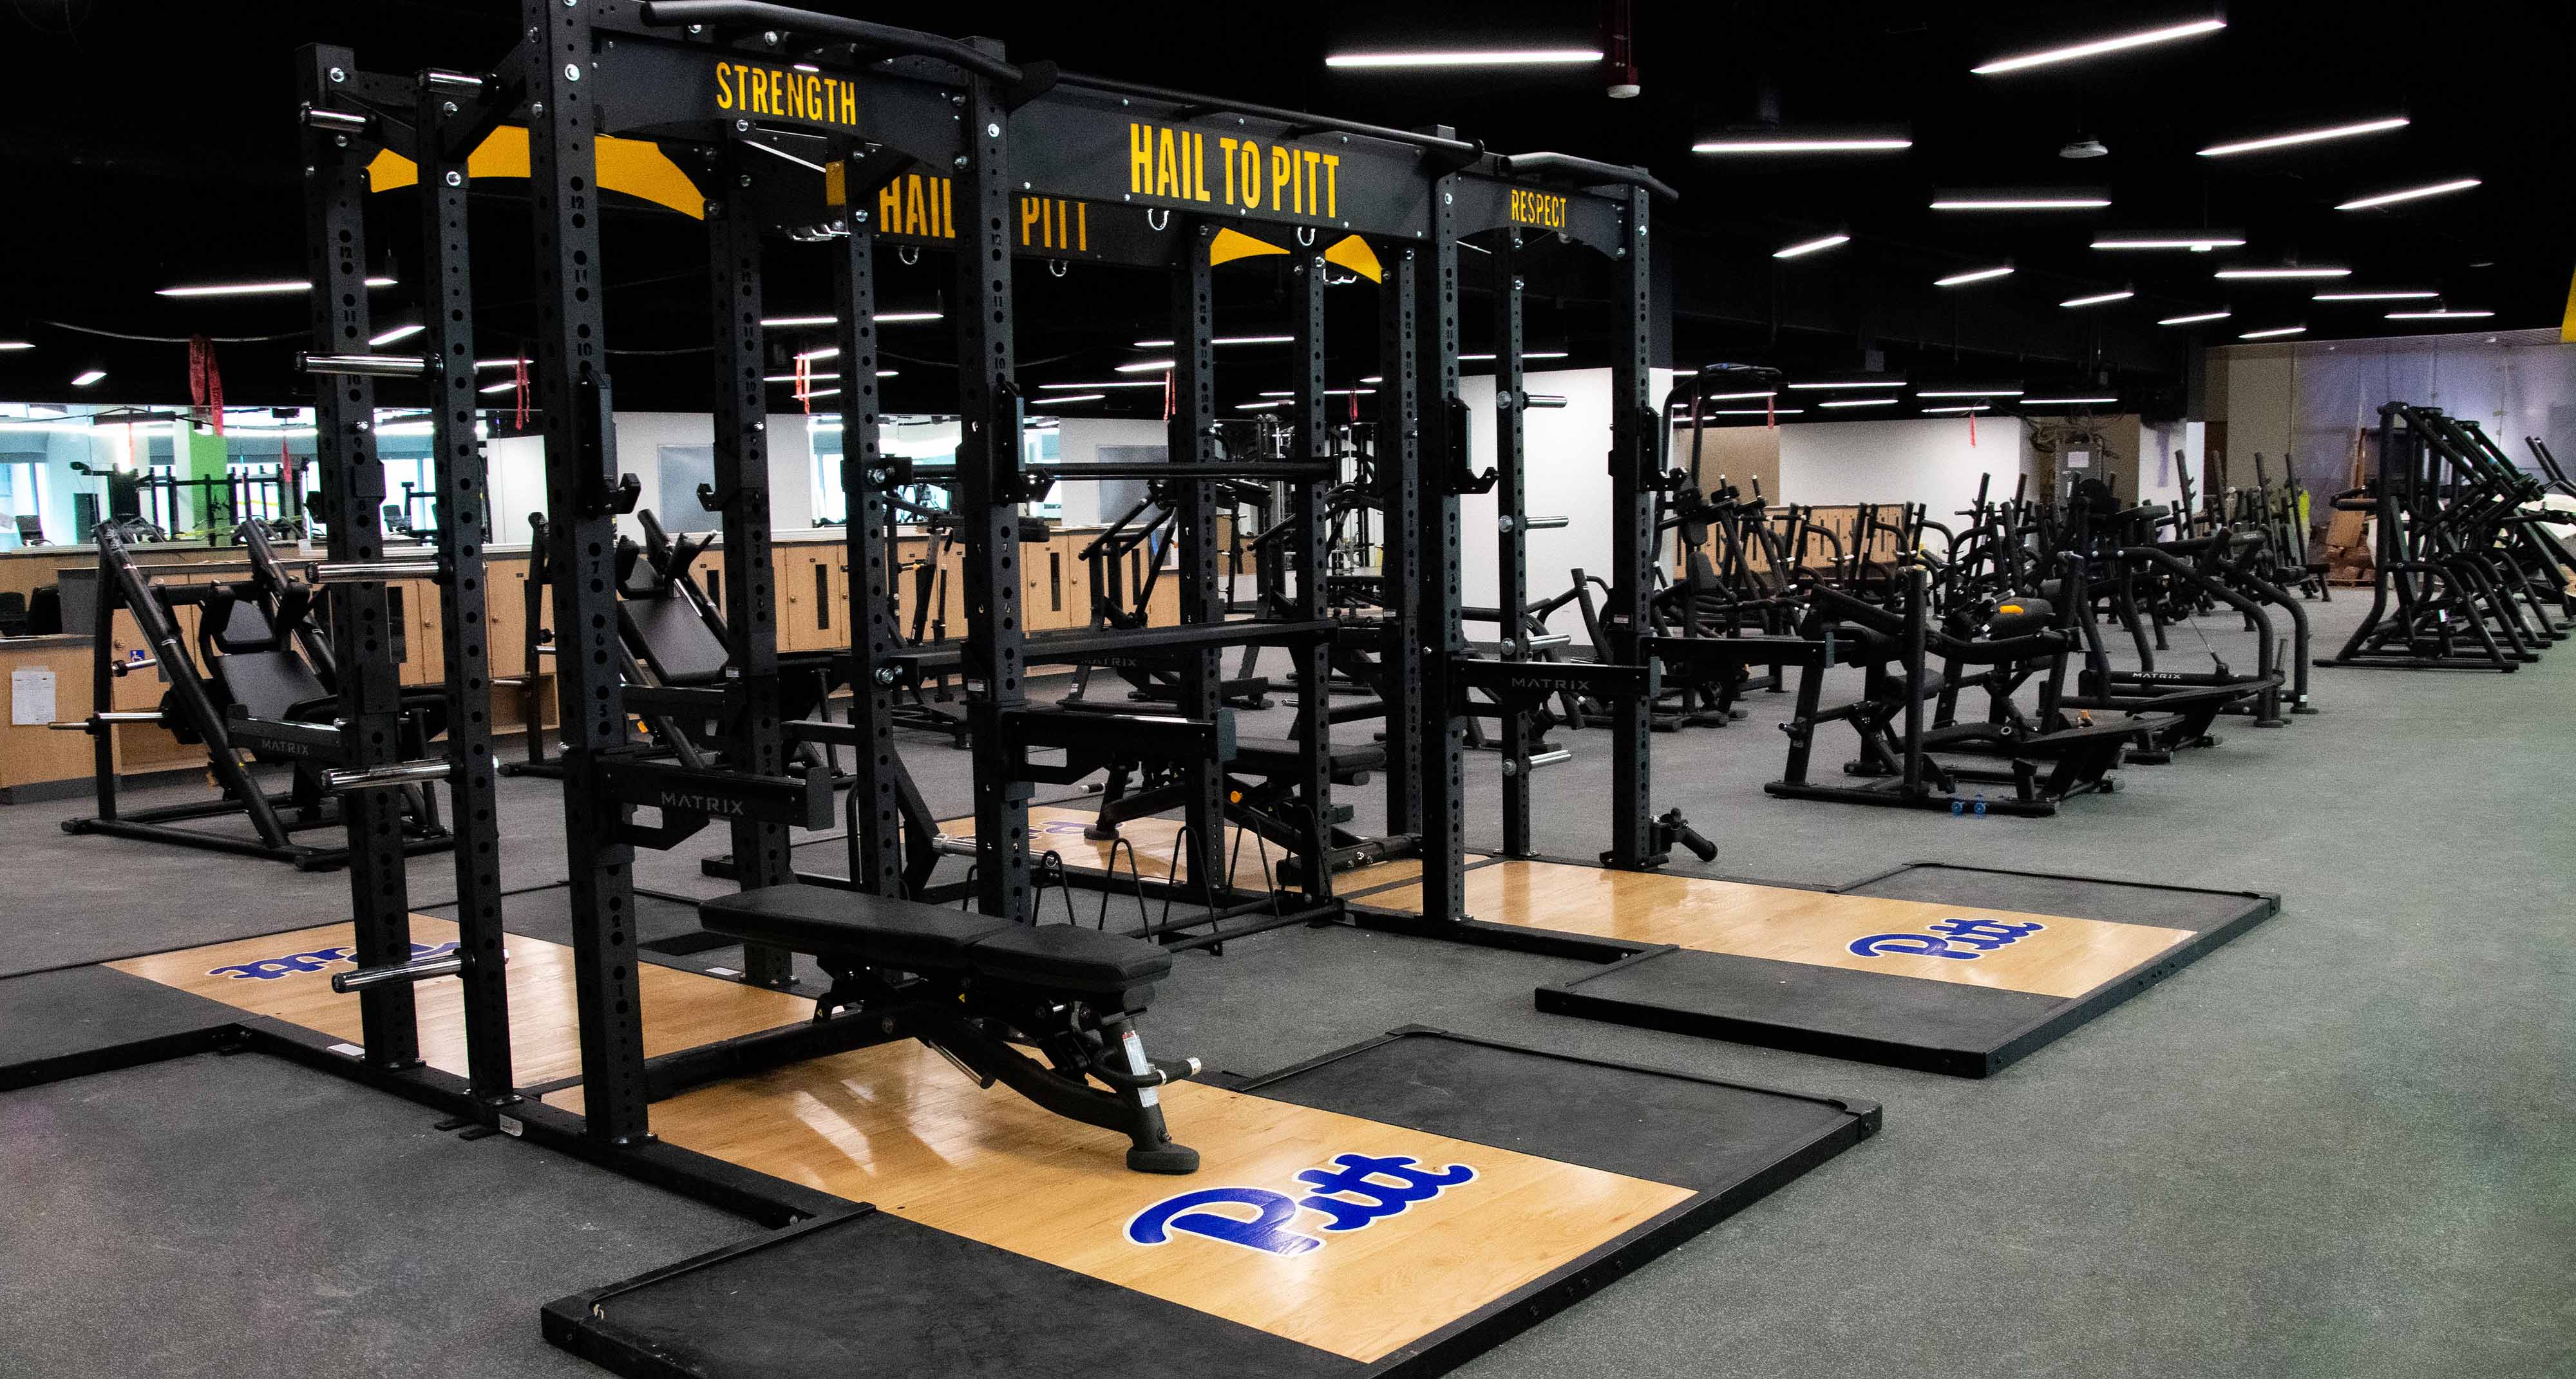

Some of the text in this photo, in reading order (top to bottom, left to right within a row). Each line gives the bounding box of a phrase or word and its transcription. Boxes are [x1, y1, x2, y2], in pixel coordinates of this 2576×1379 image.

[716, 62, 856, 125] STRENGTH
[1130, 123, 1340, 218] HAIL TO PITT
[878, 174, 956, 238] HAIL
[1511, 189, 1566, 228] RESPECT
[1511, 677, 1590, 690] MATRIX
[262, 740, 310, 755] MATRIX
[661, 791, 744, 815] MATRIX
[1846, 916, 2047, 961] Pitt
[1122, 1153, 1480, 1257] Pitt
